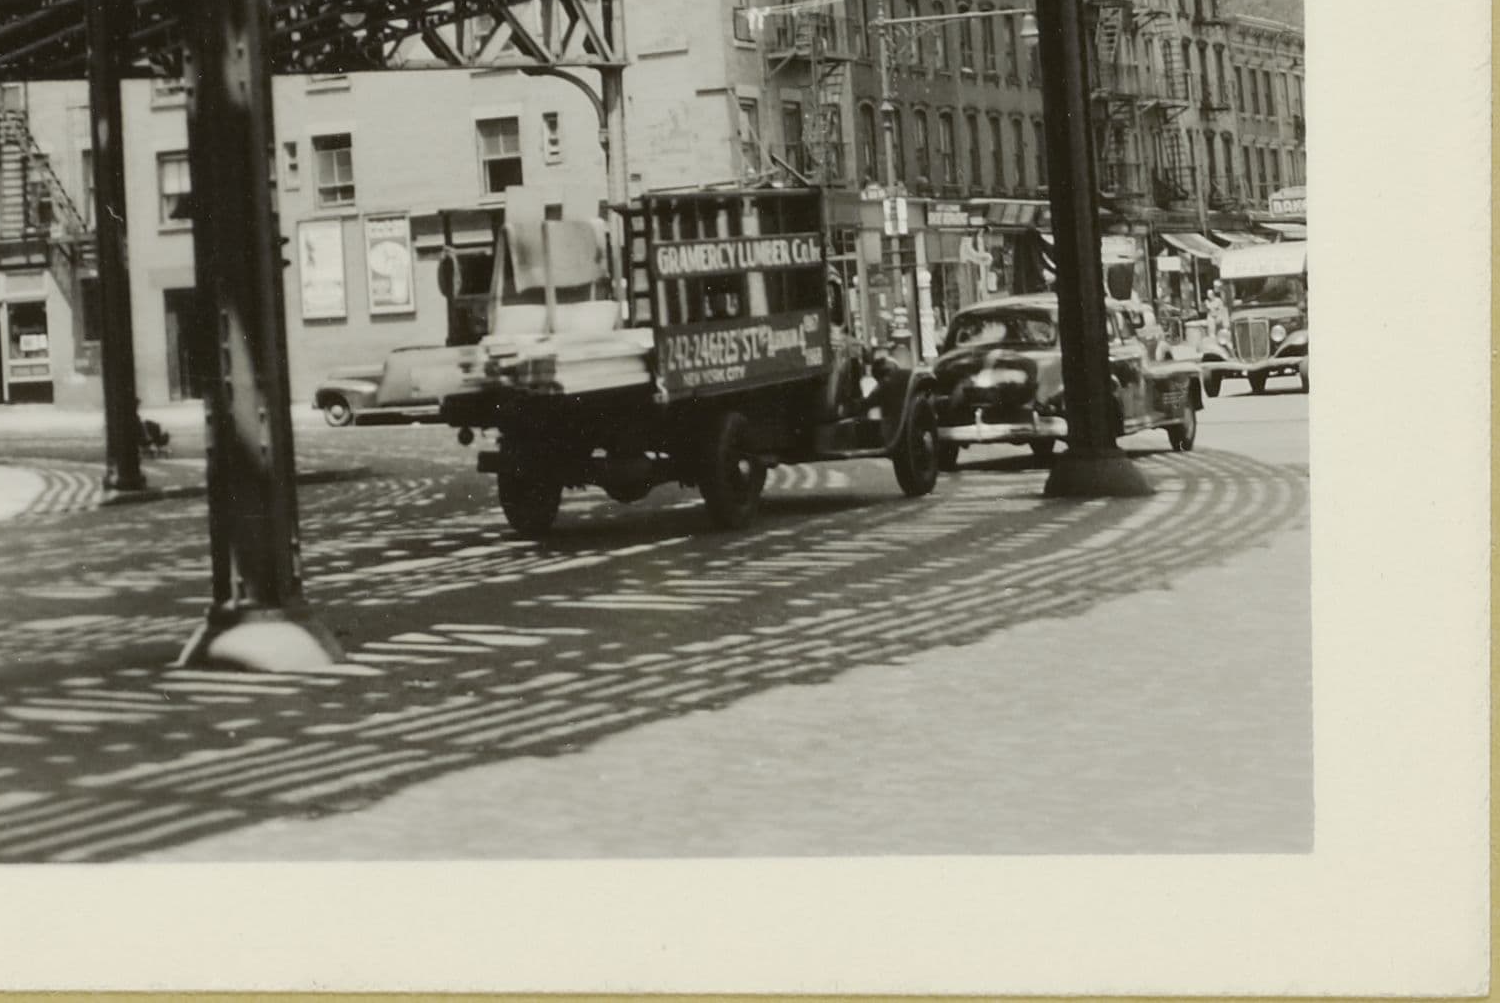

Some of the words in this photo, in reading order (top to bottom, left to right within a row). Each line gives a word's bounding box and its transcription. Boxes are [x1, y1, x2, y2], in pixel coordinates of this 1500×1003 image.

[657, 242, 737, 275] GRAMERCY
[737, 239, 791, 268] LUMBER
[726, 365, 747, 382] CITY
